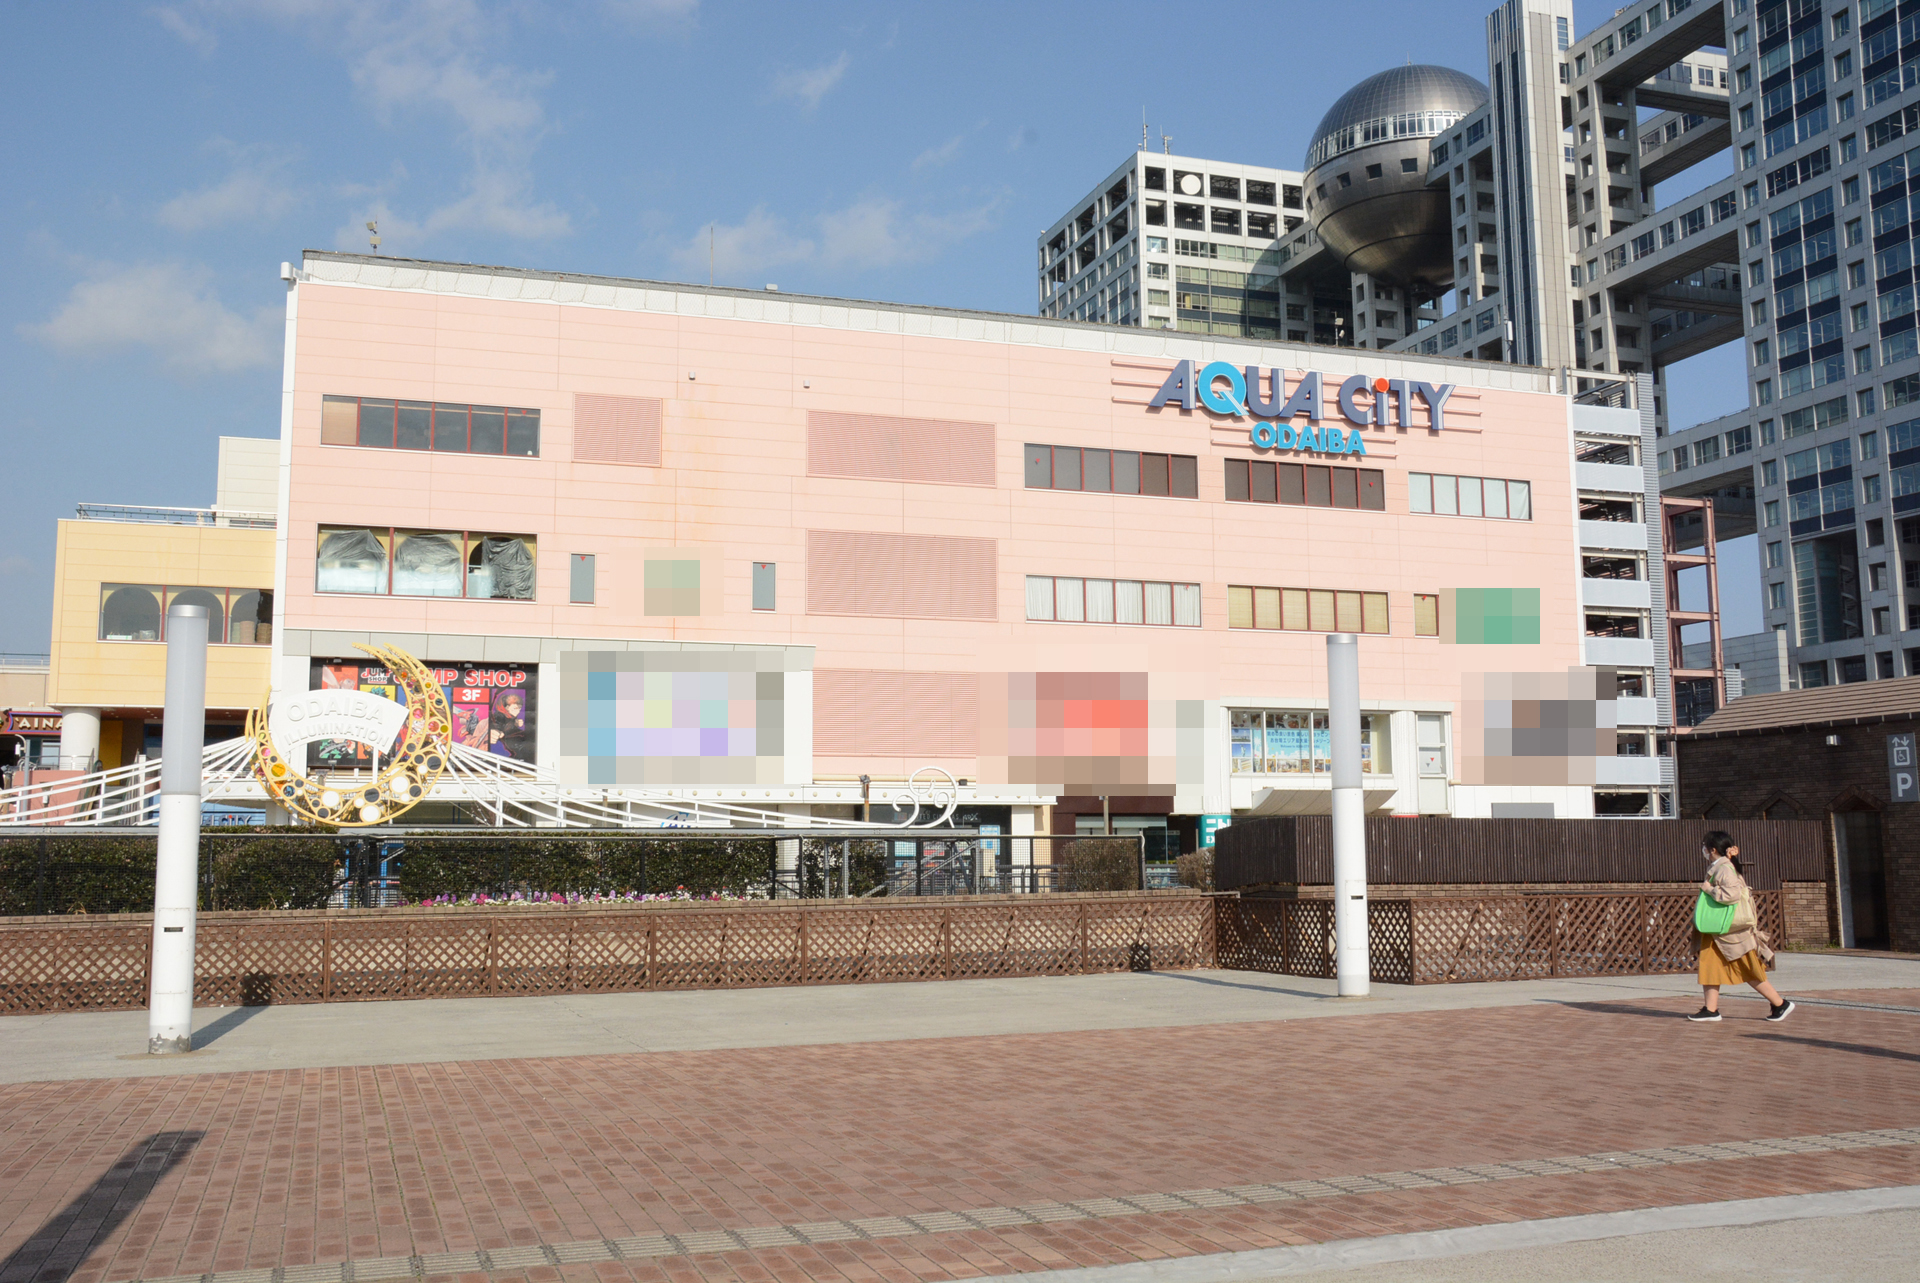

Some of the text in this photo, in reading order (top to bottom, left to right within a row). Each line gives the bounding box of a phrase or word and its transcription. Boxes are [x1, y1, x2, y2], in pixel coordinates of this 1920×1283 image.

[1149, 359, 1324, 420] AQUA
[1251, 421, 1367, 455] ODAIBA
[464, 669, 526, 687] SHOP
[462, 689, 482, 701] 3F
[286, 696, 384, 725] ODAIBA
[284, 723, 390, 747] ILLUMINATION
[1896, 772, 1912, 797] P
